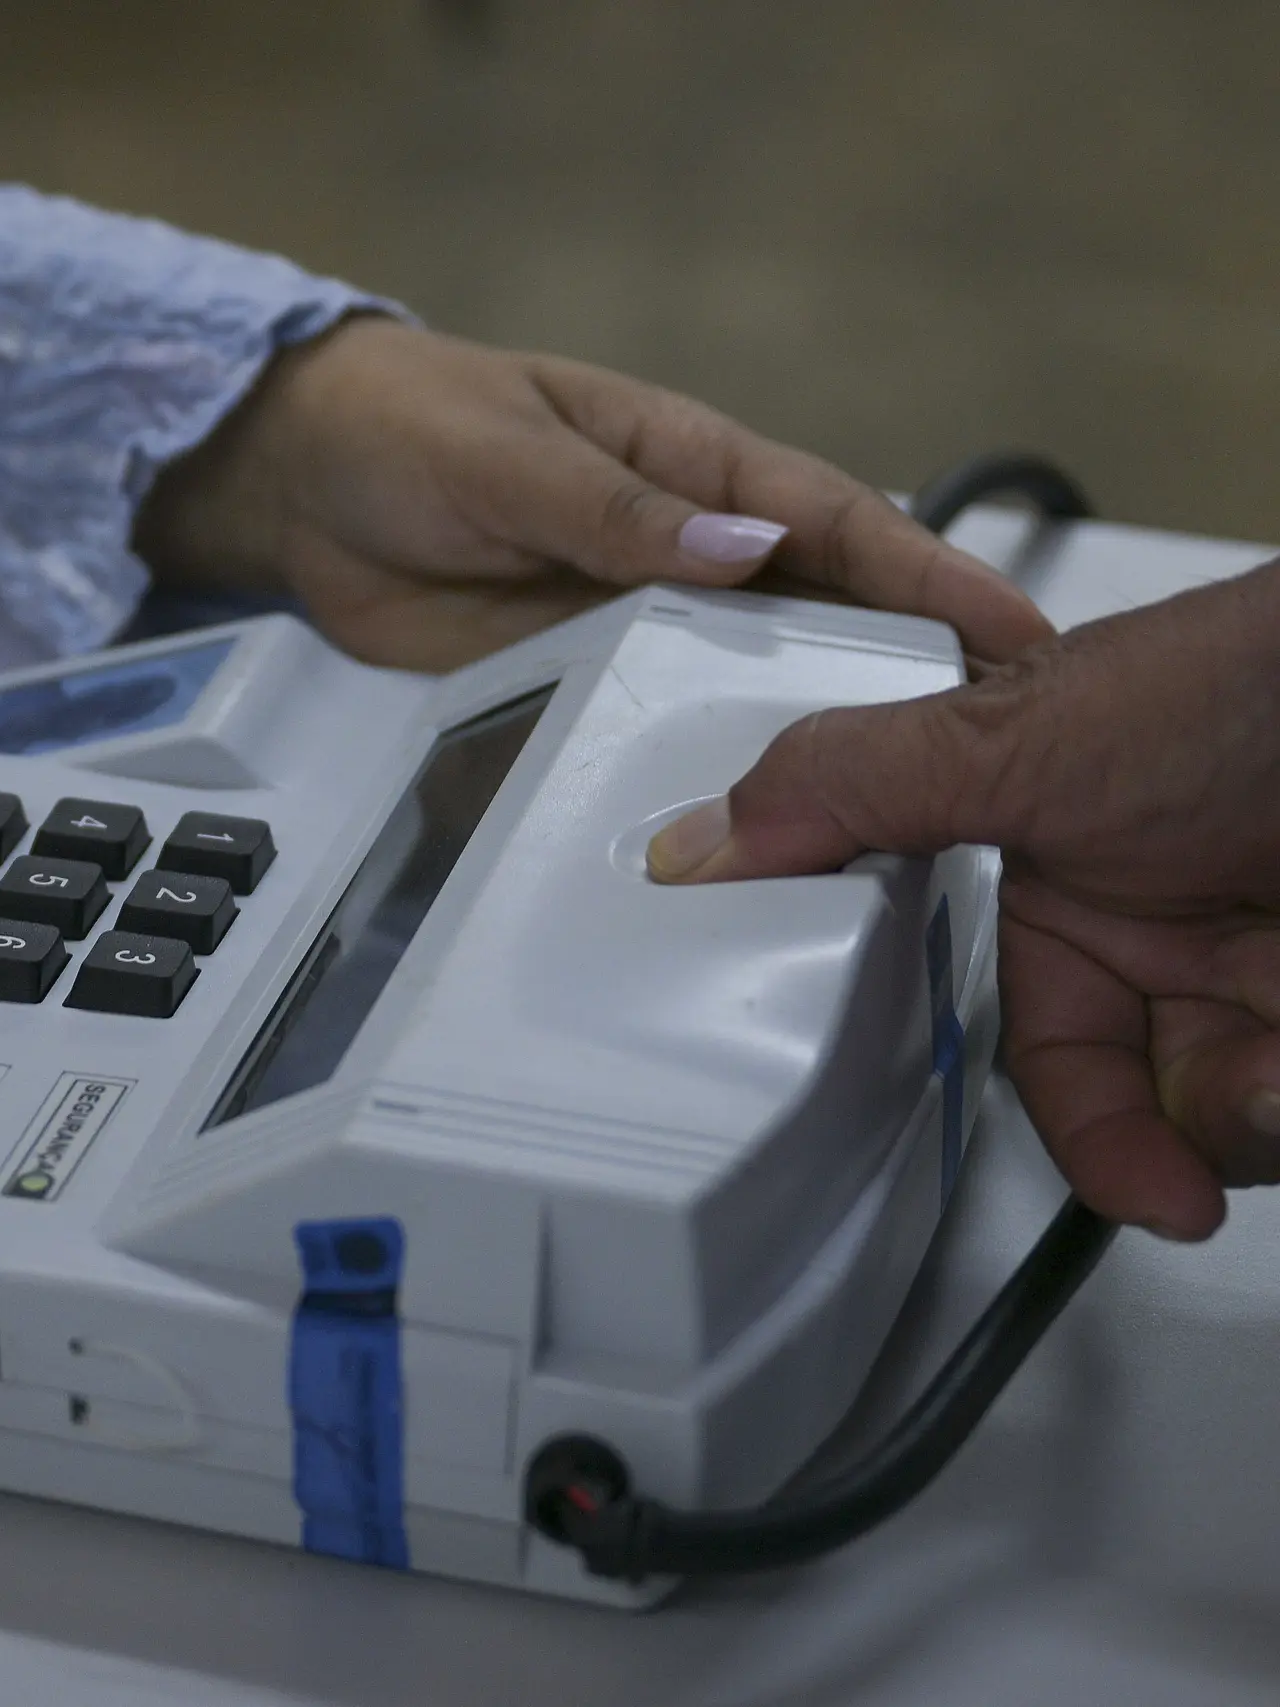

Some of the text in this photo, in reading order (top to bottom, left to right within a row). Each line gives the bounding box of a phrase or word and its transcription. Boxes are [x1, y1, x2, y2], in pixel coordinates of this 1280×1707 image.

[70, 815, 108, 830] 4
[196, 832, 234, 843] 1
[29, 873, 69, 888] 5
[155, 887, 197, 904] 2
[114, 949, 157, 965] 3
